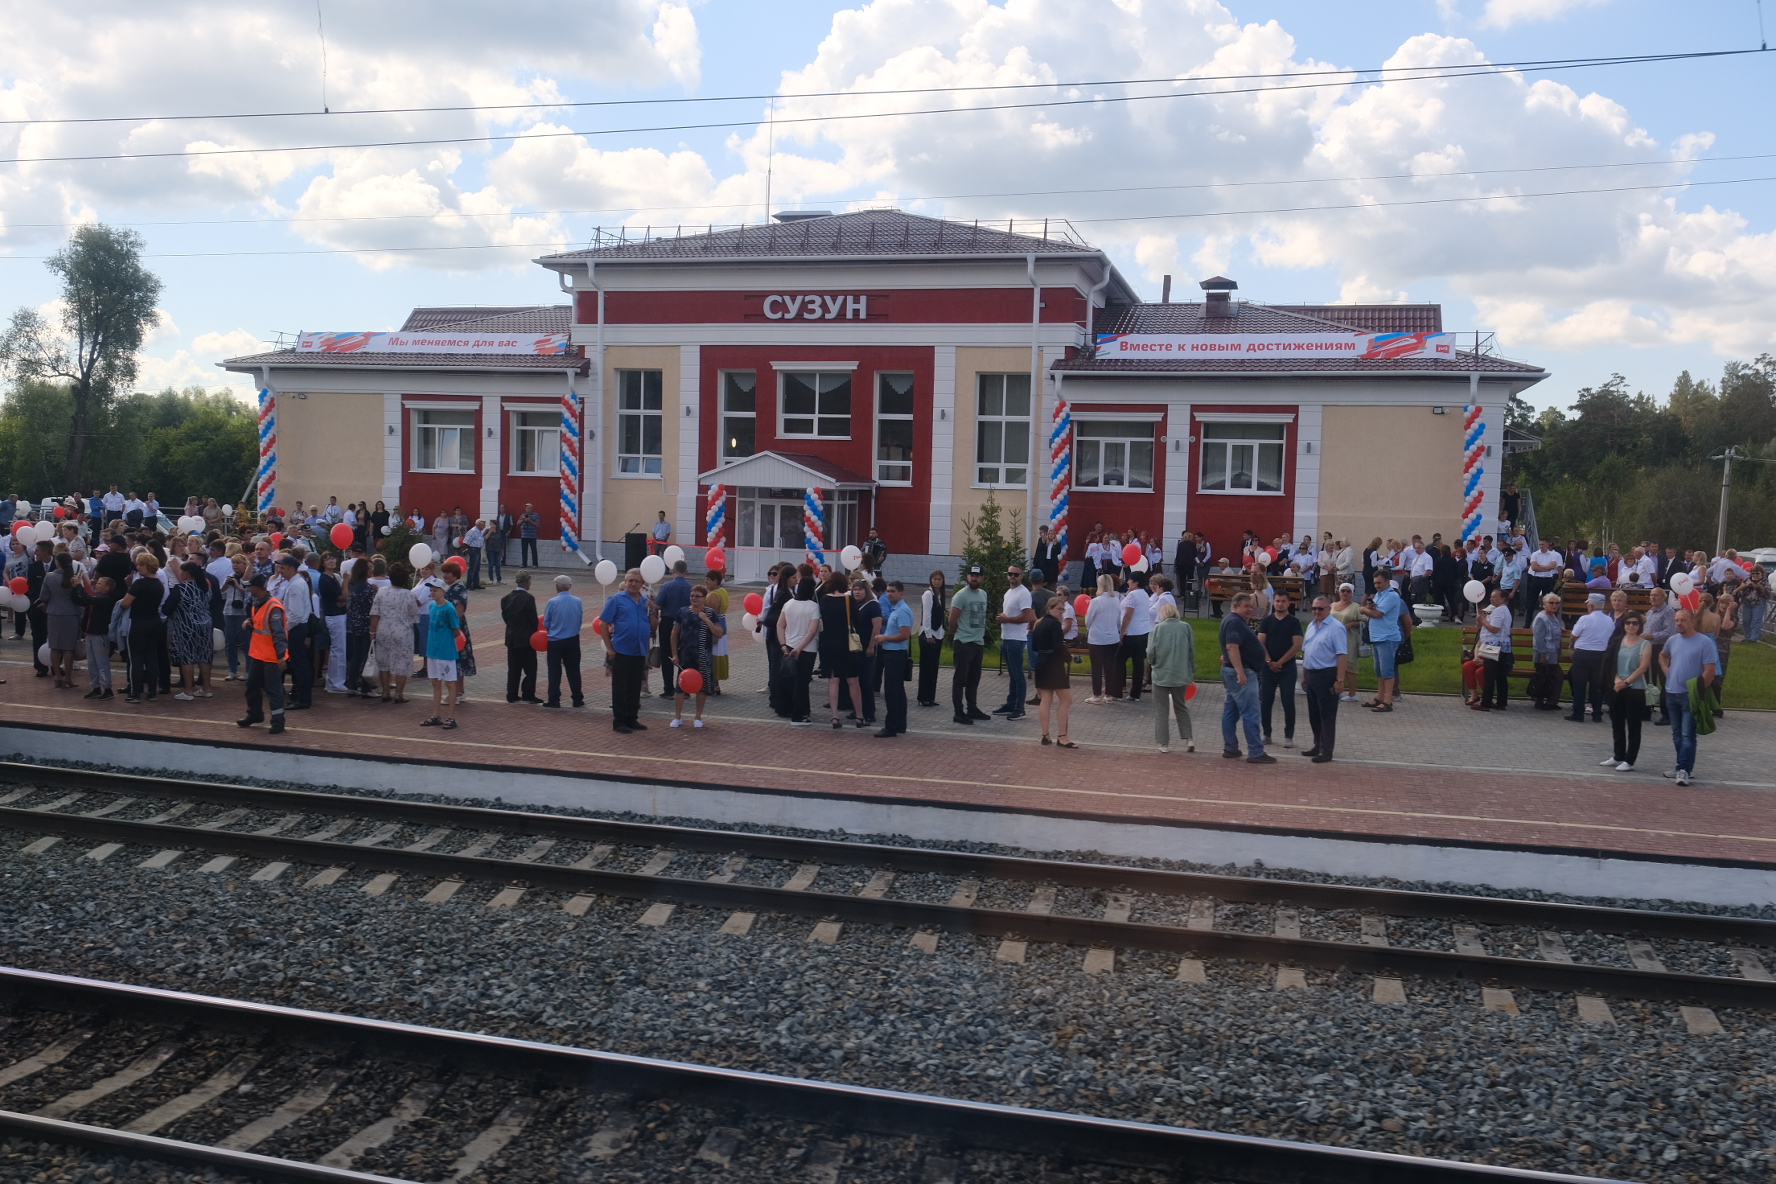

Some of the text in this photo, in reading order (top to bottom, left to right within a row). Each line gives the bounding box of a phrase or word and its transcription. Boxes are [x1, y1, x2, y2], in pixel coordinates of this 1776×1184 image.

[763, 294, 867, 320] СУЗУН
[387, 337, 518, 348] Мы меняемся для вас
[1120, 341, 1356, 353] Вместе к новым достижениям
